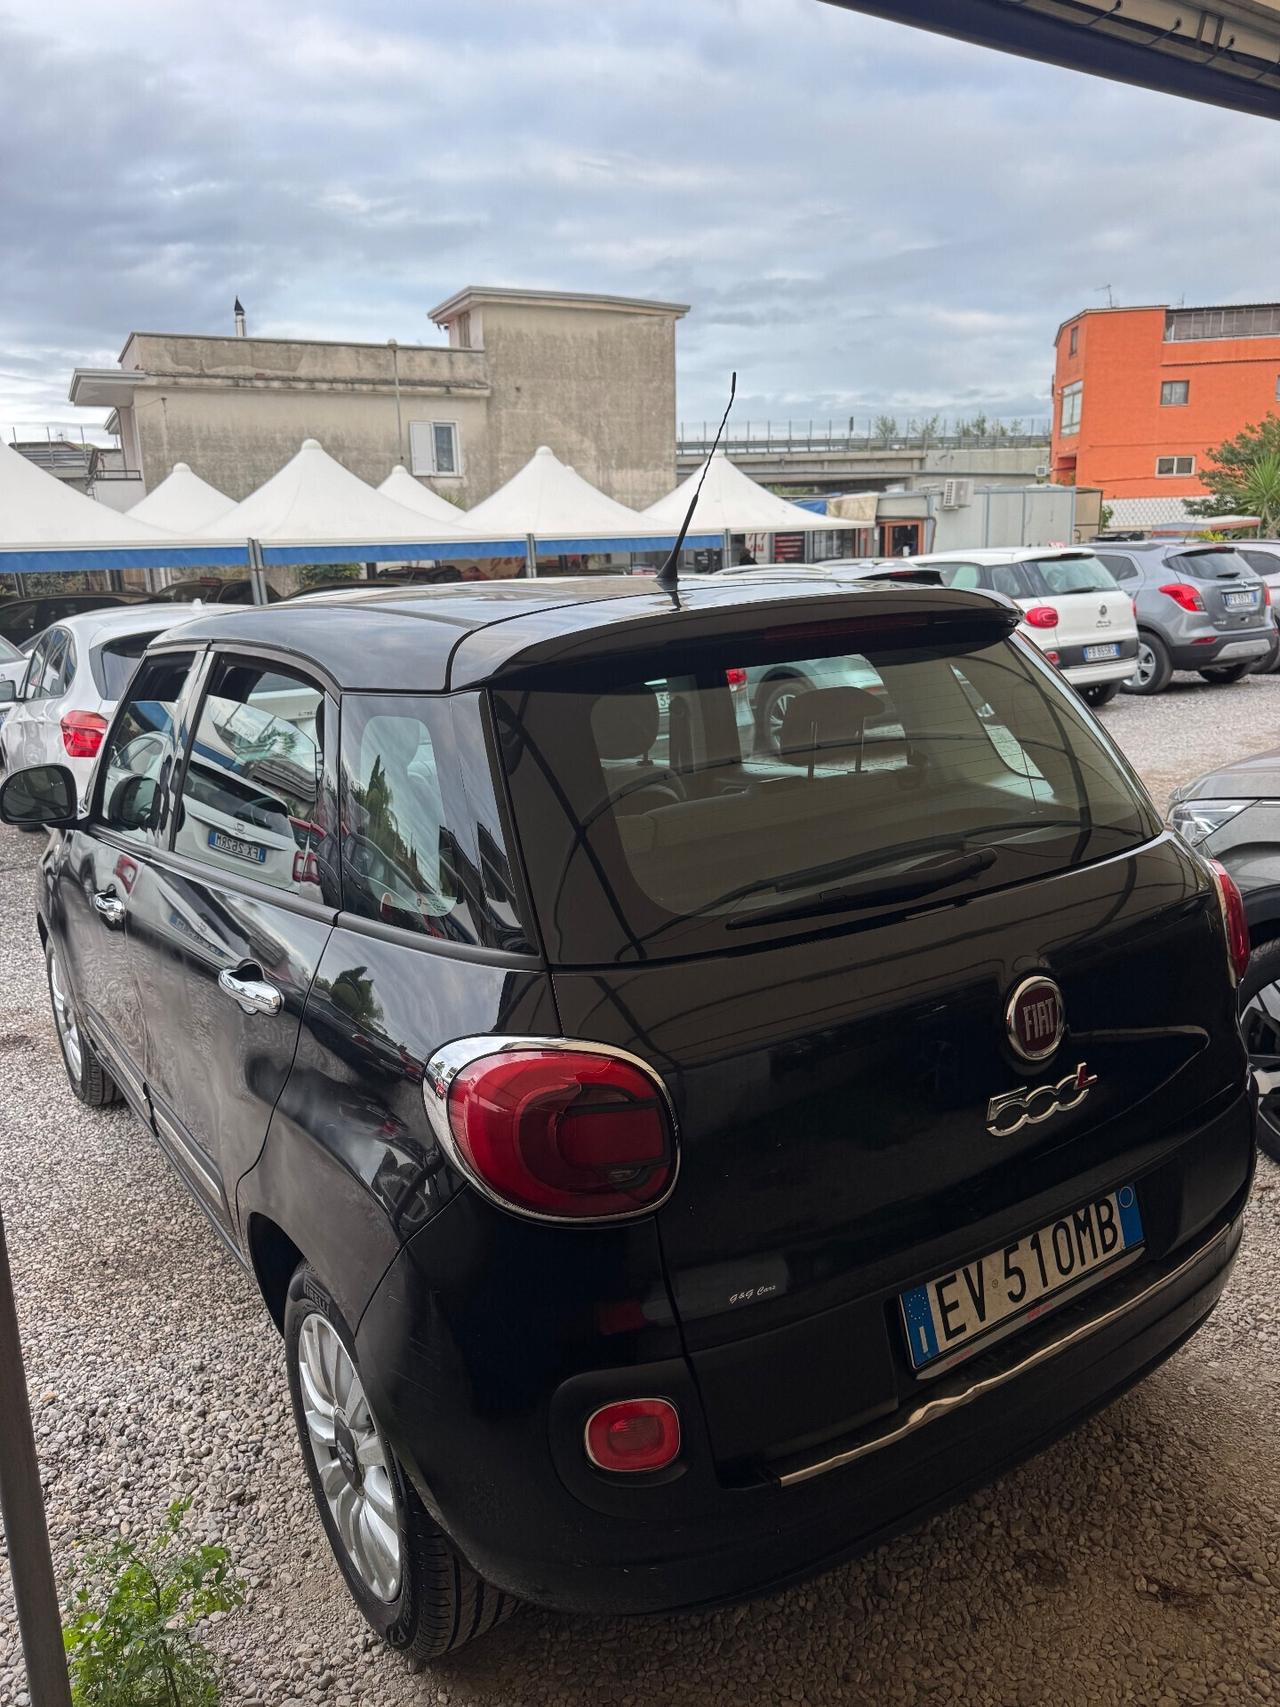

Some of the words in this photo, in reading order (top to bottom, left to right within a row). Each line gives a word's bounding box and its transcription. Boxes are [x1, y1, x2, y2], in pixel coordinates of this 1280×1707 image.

[1022, 998, 1056, 1041] FIAT
[986, 1062, 1098, 1137] 500L
[729, 1289, 755, 1304] G&G
[757, 1285, 776, 1296] Cars
[935, 1260, 986, 1342] EV
[1003, 1198, 1118, 1304] 510MB
